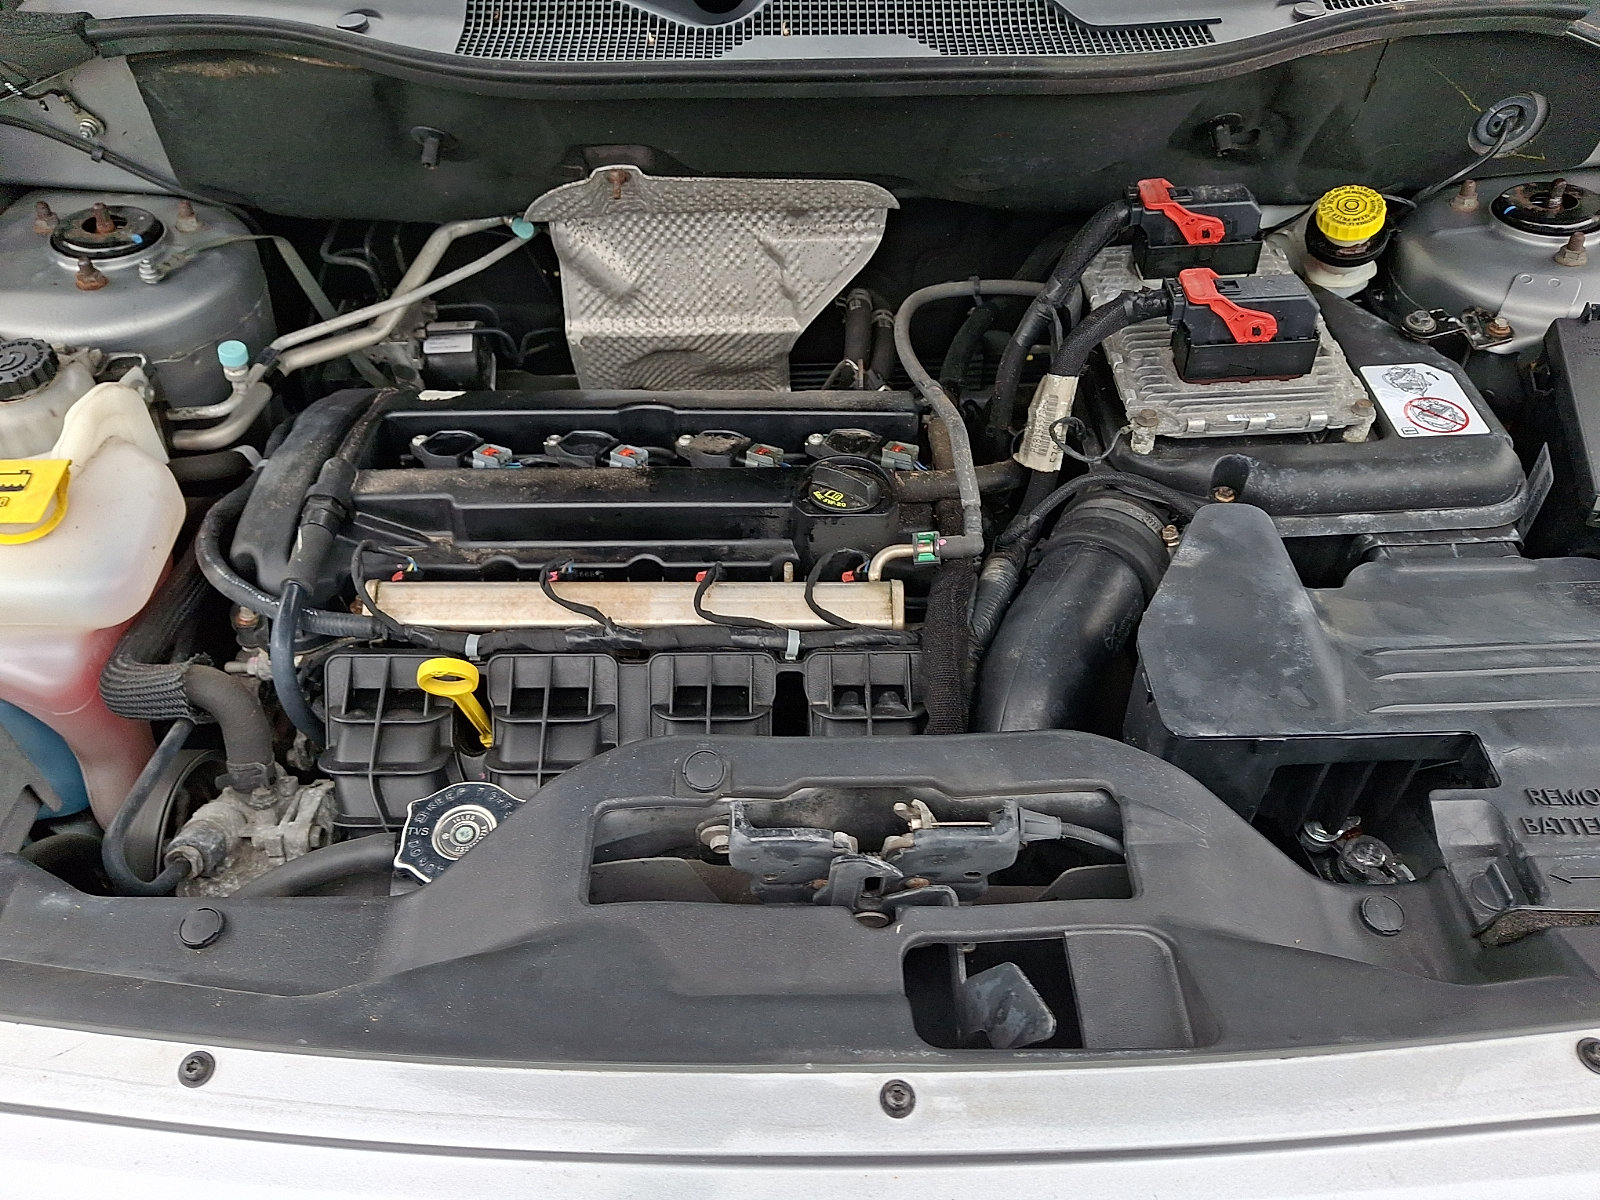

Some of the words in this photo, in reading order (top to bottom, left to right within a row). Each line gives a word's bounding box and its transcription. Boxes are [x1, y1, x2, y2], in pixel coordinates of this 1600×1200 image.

[1524, 787, 1600, 807] REMO
[407, 827, 430, 836] TVS
[1520, 816, 1600, 836] BATTE
